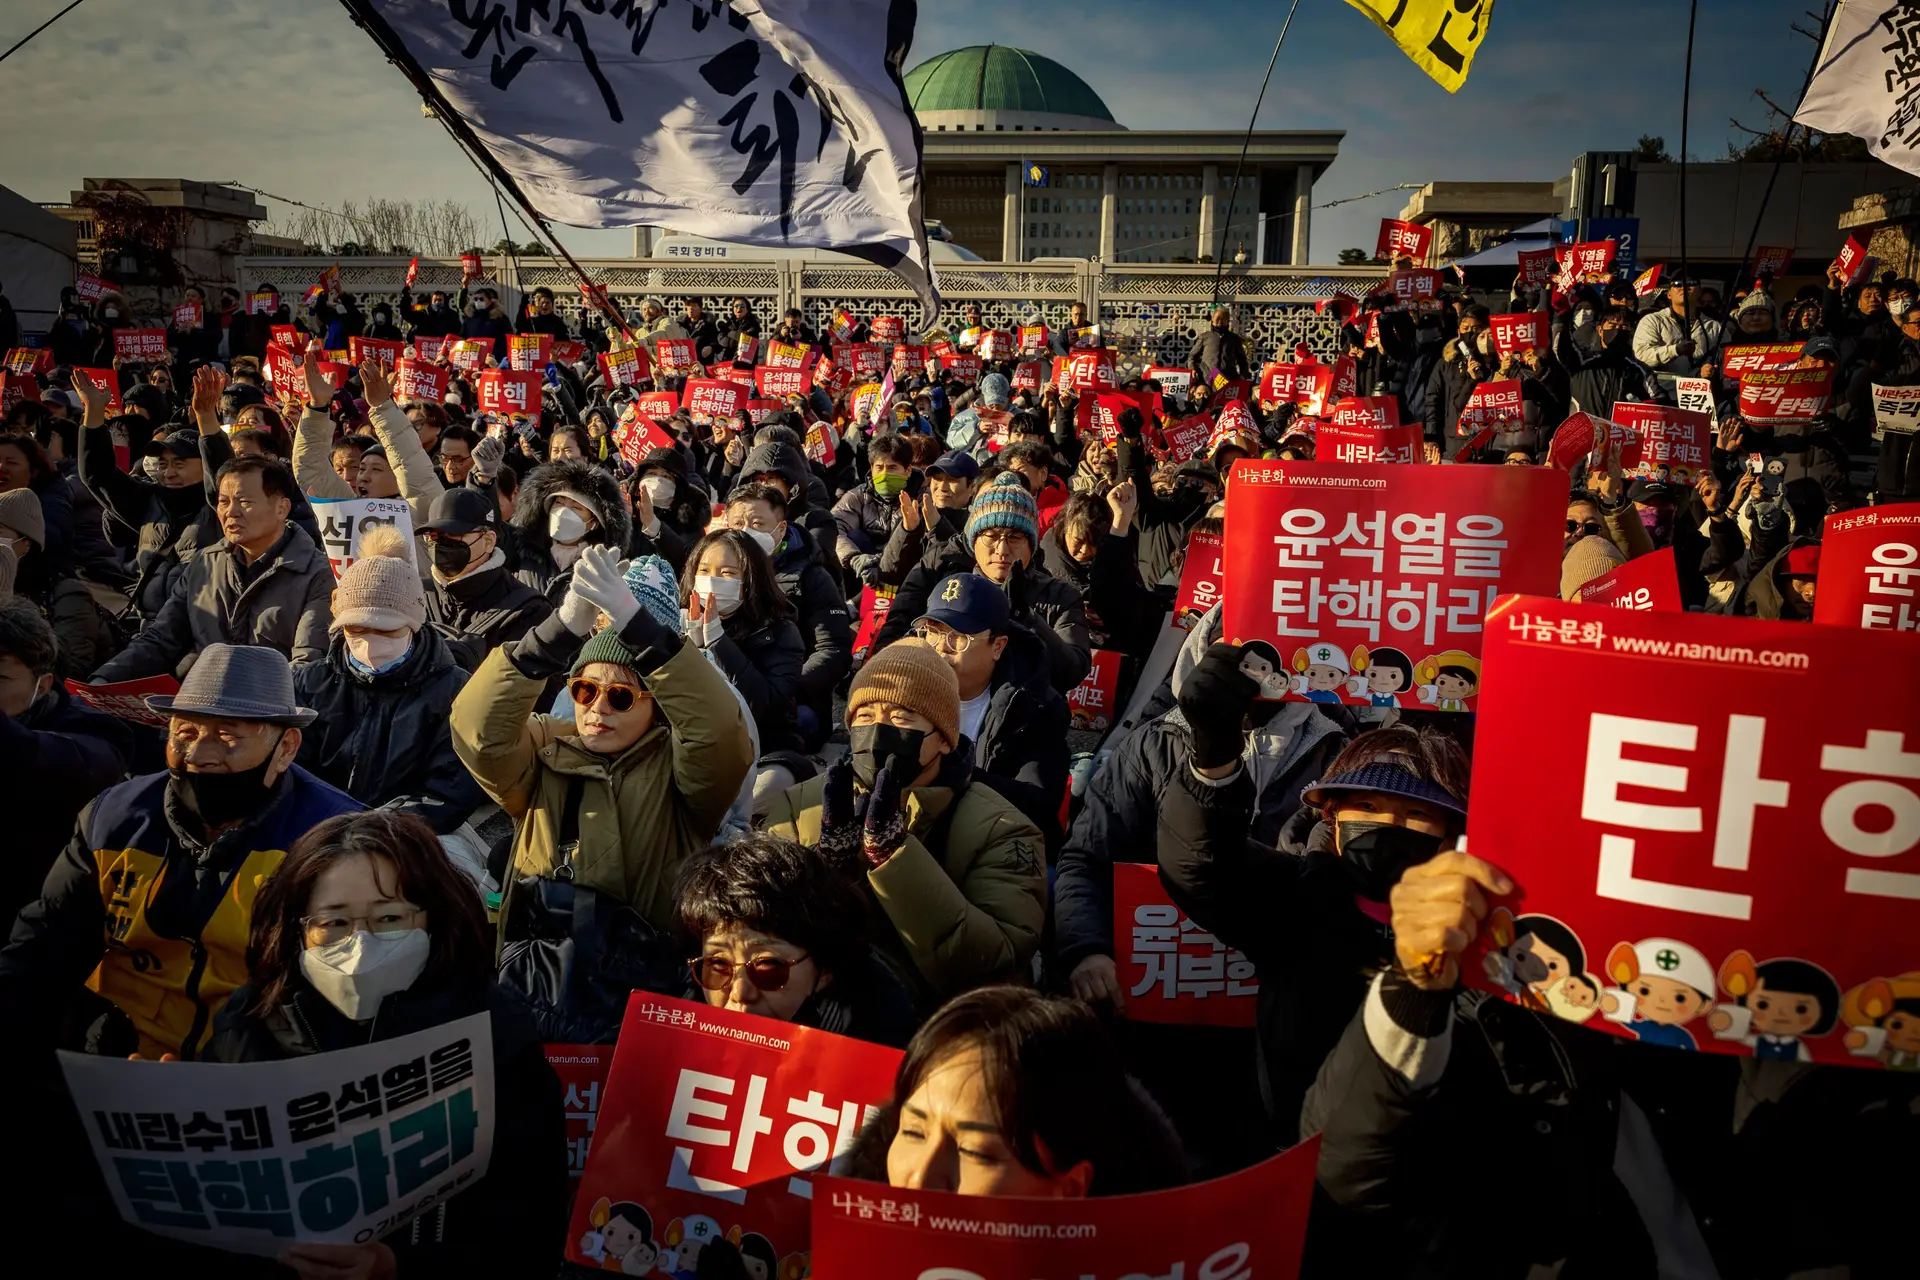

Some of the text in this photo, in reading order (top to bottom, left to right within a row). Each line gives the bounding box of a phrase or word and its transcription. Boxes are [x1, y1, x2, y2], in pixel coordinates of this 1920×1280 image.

[1389, 229, 1420, 254] 탄핵
[1620, 233, 1632, 250] 2
[668, 246, 727, 257] 국회경비대
[1840, 244, 1854, 269] 핵
[1396, 276, 1433, 298] 탄핵
[276, 331, 295, 348] 탄핵
[511, 337, 539, 348] 내란죄
[1497, 322, 1537, 348] 탄핵
[362, 346, 395, 366] 탄핵
[511, 348, 540, 360] 윤석열
[605, 350, 636, 367] 내란죄
[660, 346, 689, 356] 윤석열을
[775, 343, 805, 360] 내란죄
[1727, 344, 1803, 356] 내란수괴 윤석열
[608, 359, 640, 379] 윤석열
[660, 356, 690, 367] 탄핵하라
[1726, 355, 1765, 370] 즉각
[763, 371, 802, 384] 윤석열을
[1076, 363, 1116, 389] 탄핵
[1741, 371, 1829, 385] 내란수괴 윤석열
[416, 383, 440, 401] 체포
[484, 380, 527, 410] 탄핵
[693, 387, 737, 403] 윤석열을
[763, 382, 801, 395] 탄핵하라
[1272, 374, 1316, 399] 탄핵
[1678, 381, 1710, 392] 내란수괴
[1741, 385, 1786, 404] 즉각
[639, 401, 671, 414] 윤석열을
[1483, 391, 1519, 407] 힘으로
[1680, 393, 1708, 410] 즉각
[1775, 396, 1828, 416] 탄핵!
[690, 401, 734, 417] 탄핵하라
[1334, 408, 1386, 425] 내란수괴
[1487, 405, 1520, 420] 지키자
[1173, 422, 1210, 444] 내란수괴
[1632, 419, 1695, 444] 내란수괴
[1672, 443, 1702, 463] 체포
[1237, 468, 1387, 489] 나눔문화 www.nanum.com
[1832, 512, 1878, 531] 나눔문화
[1273, 508, 1508, 578] 윤석열을
[1508, 613, 1810, 670] 나눔문화 www.nanum.com
[1071, 686, 1105, 708] 체포
[640, 1003, 790, 1051] 나눔문화 www.nanum.com
[545, 1055, 600, 1065] nanum.com
[93, 1105, 274, 1153] 내란수괴
[286, 1038, 474, 1144] 윤석열을
[112, 1086, 479, 1238] 탄핵하라
[832, 1191, 1097, 1239] 나눔문화 www.nanum.com
